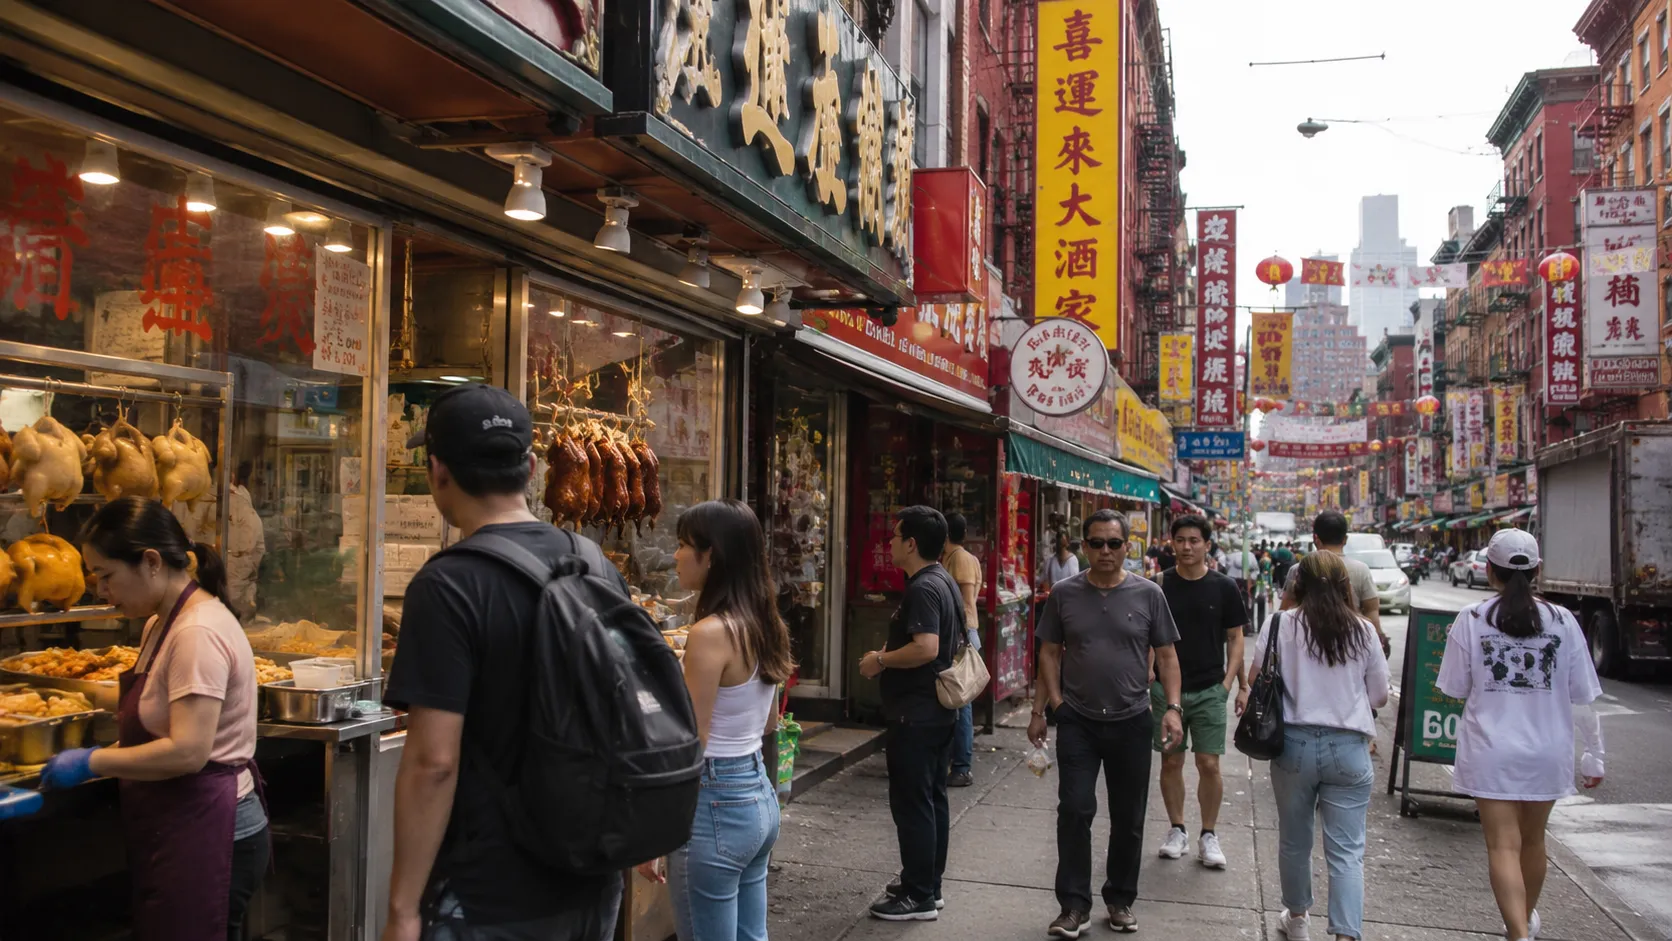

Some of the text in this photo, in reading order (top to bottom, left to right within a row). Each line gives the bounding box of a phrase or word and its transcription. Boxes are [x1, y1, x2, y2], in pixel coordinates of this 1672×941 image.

[1053, 9, 1103, 329] 喜運來大酒家
